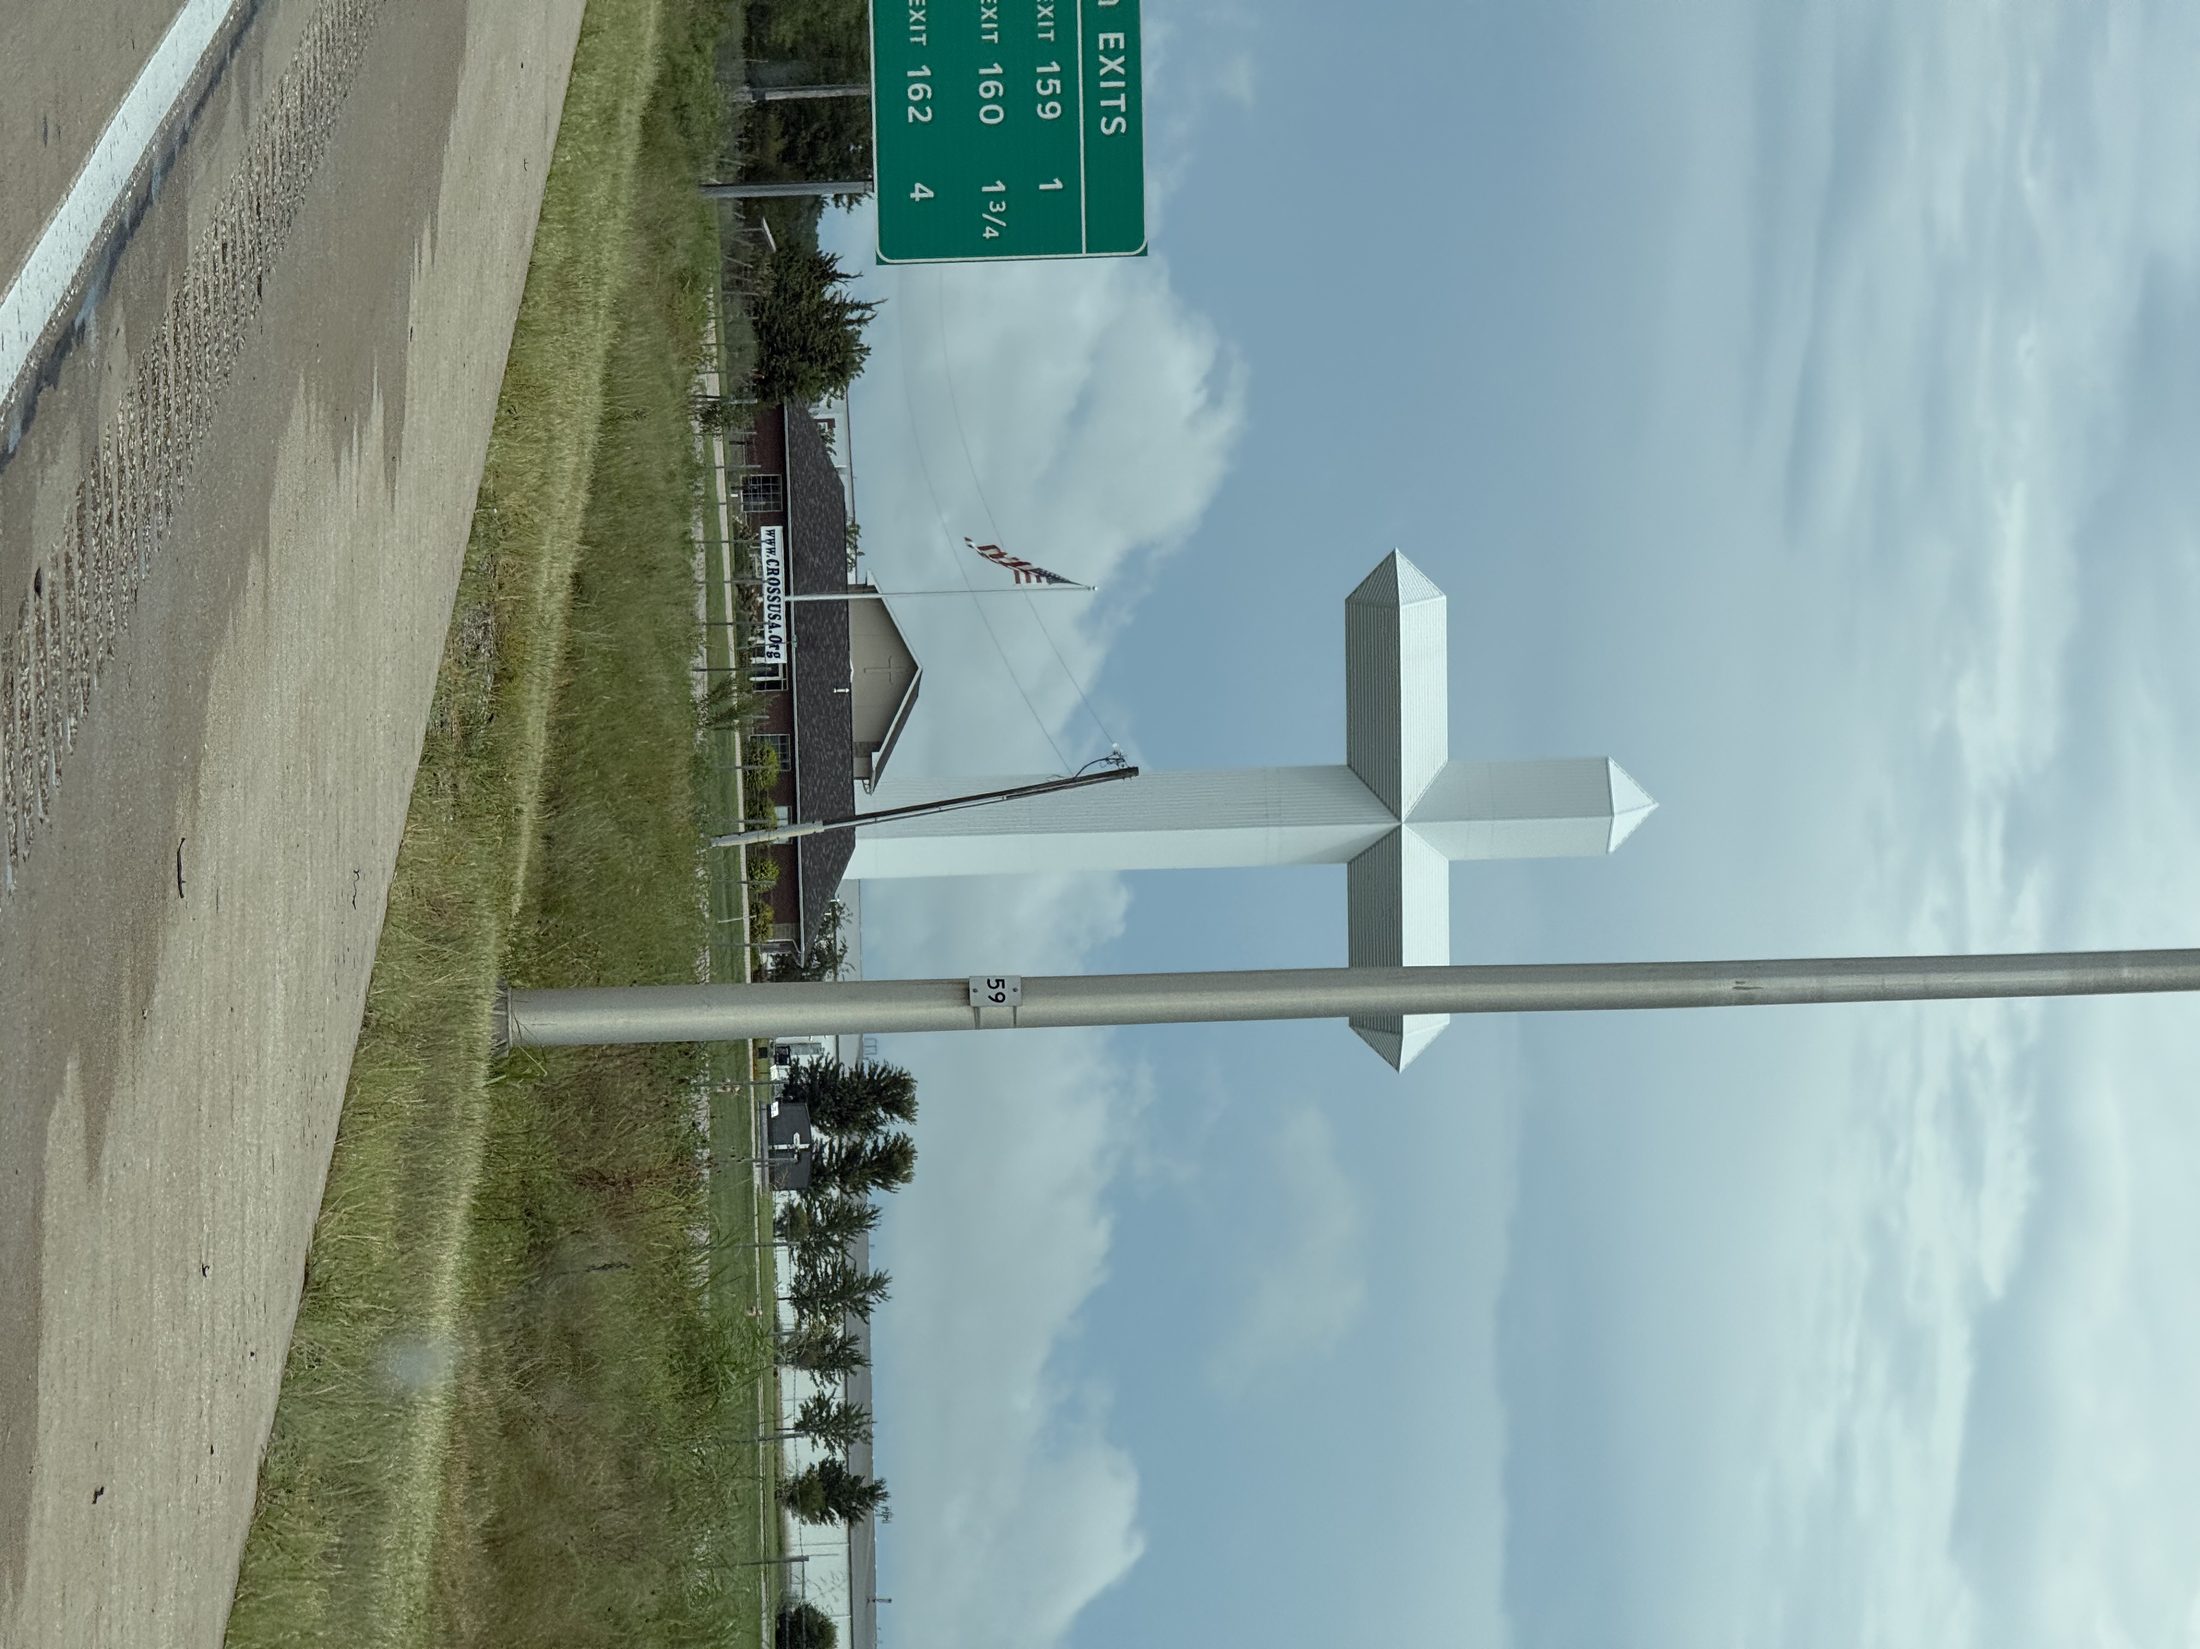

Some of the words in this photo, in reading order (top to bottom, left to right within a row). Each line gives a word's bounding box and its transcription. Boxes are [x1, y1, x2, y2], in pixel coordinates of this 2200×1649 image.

[1037, 0, 1055, 42] XIT
[907, 65, 933, 123] 162
[978, 62, 1005, 125] 160
[1036, 61, 1062, 120] 159
[1098, 32, 1126, 135] EXITS
[909, 182, 934, 202] 4
[1038, 178, 1063, 191] 1
[986, 978, 1006, 1004] 59
